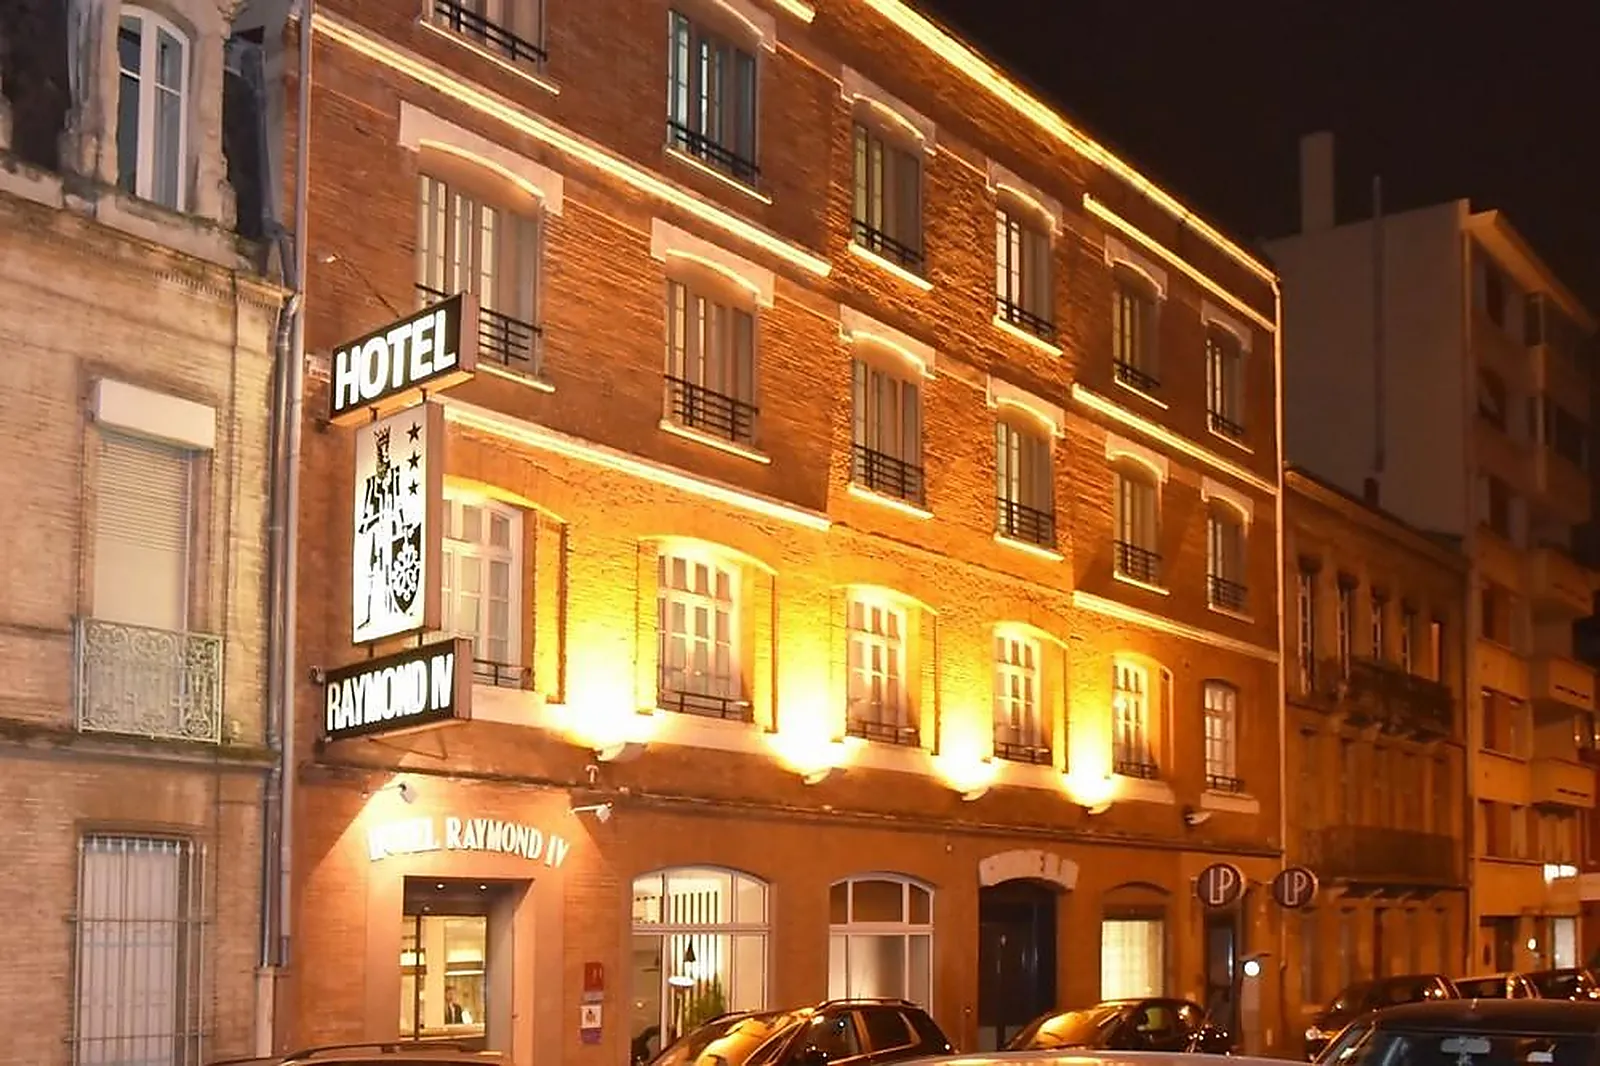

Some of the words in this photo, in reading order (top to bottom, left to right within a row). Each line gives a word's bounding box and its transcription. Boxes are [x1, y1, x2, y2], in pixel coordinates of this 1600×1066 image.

[335, 310, 456, 411] HOTEL
[327, 660, 427, 731] RAYMOND
[431, 653, 454, 710] IV
[446, 817, 543, 860] RAYMOND
[544, 836, 570, 868] IV
